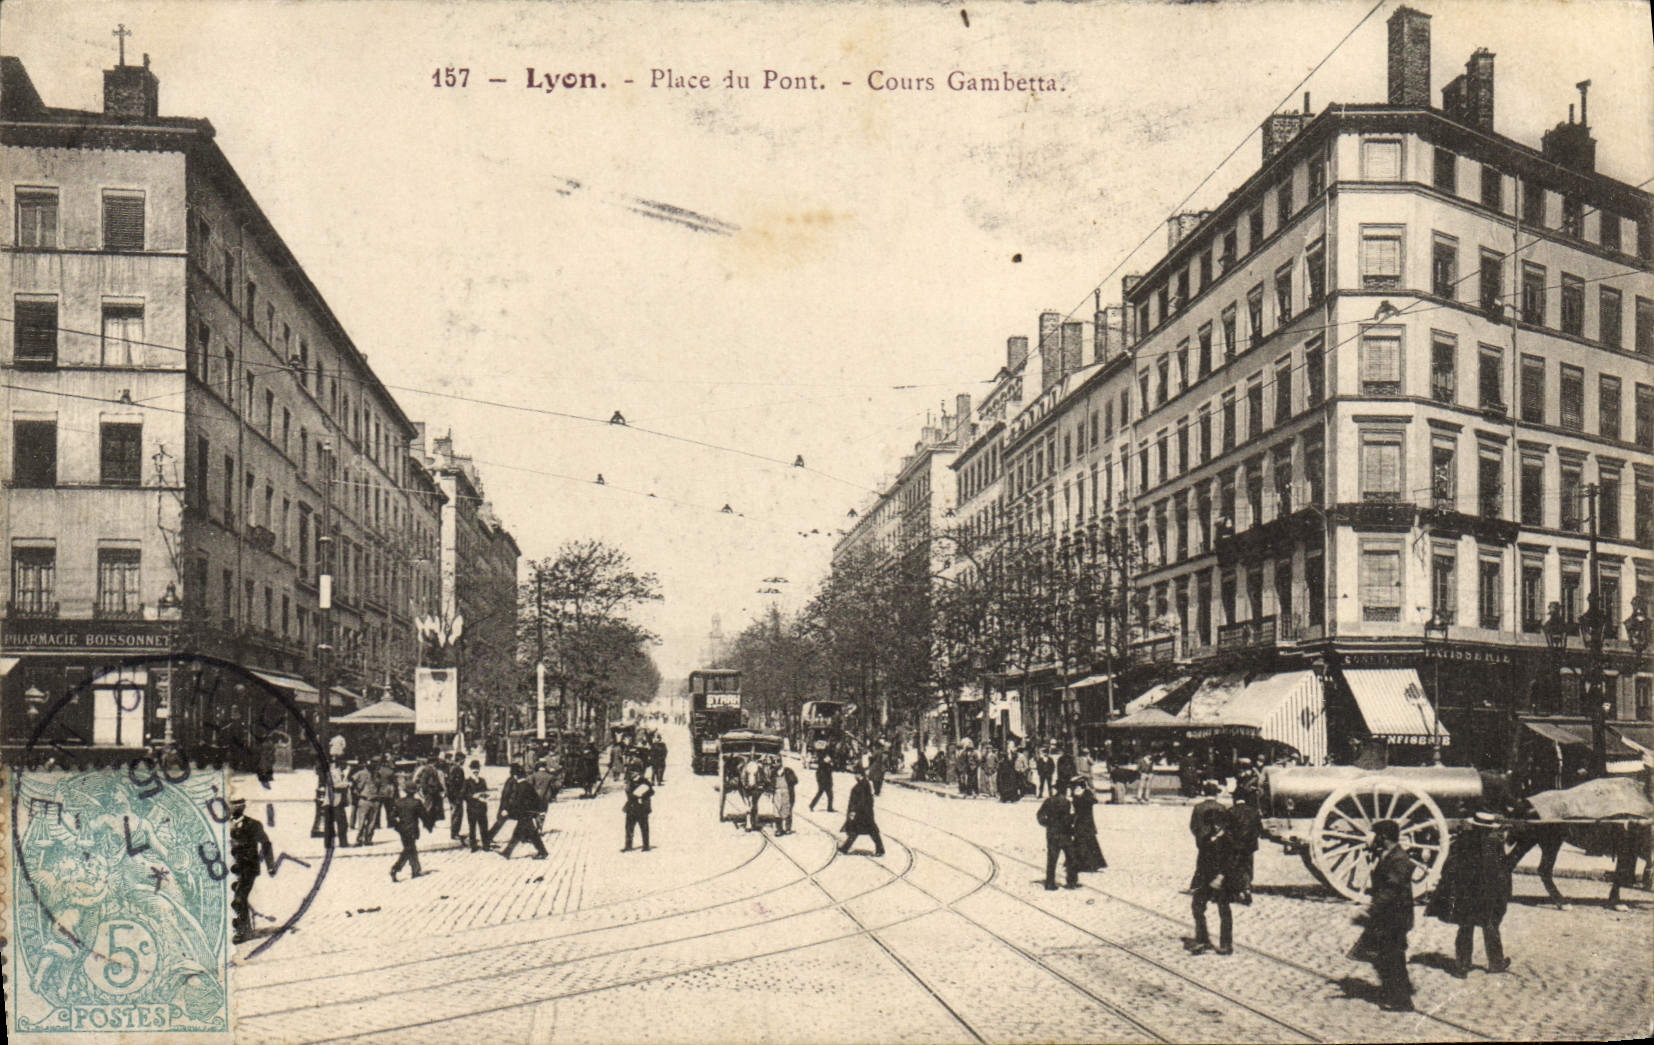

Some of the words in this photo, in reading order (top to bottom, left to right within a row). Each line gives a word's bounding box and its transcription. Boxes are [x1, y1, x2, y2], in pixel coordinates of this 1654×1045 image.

[3, 633, 77, 647] PHARMACIE
[85, 633, 170, 647] BOISSONNET
[74, 1006, 166, 1029] POSTES
